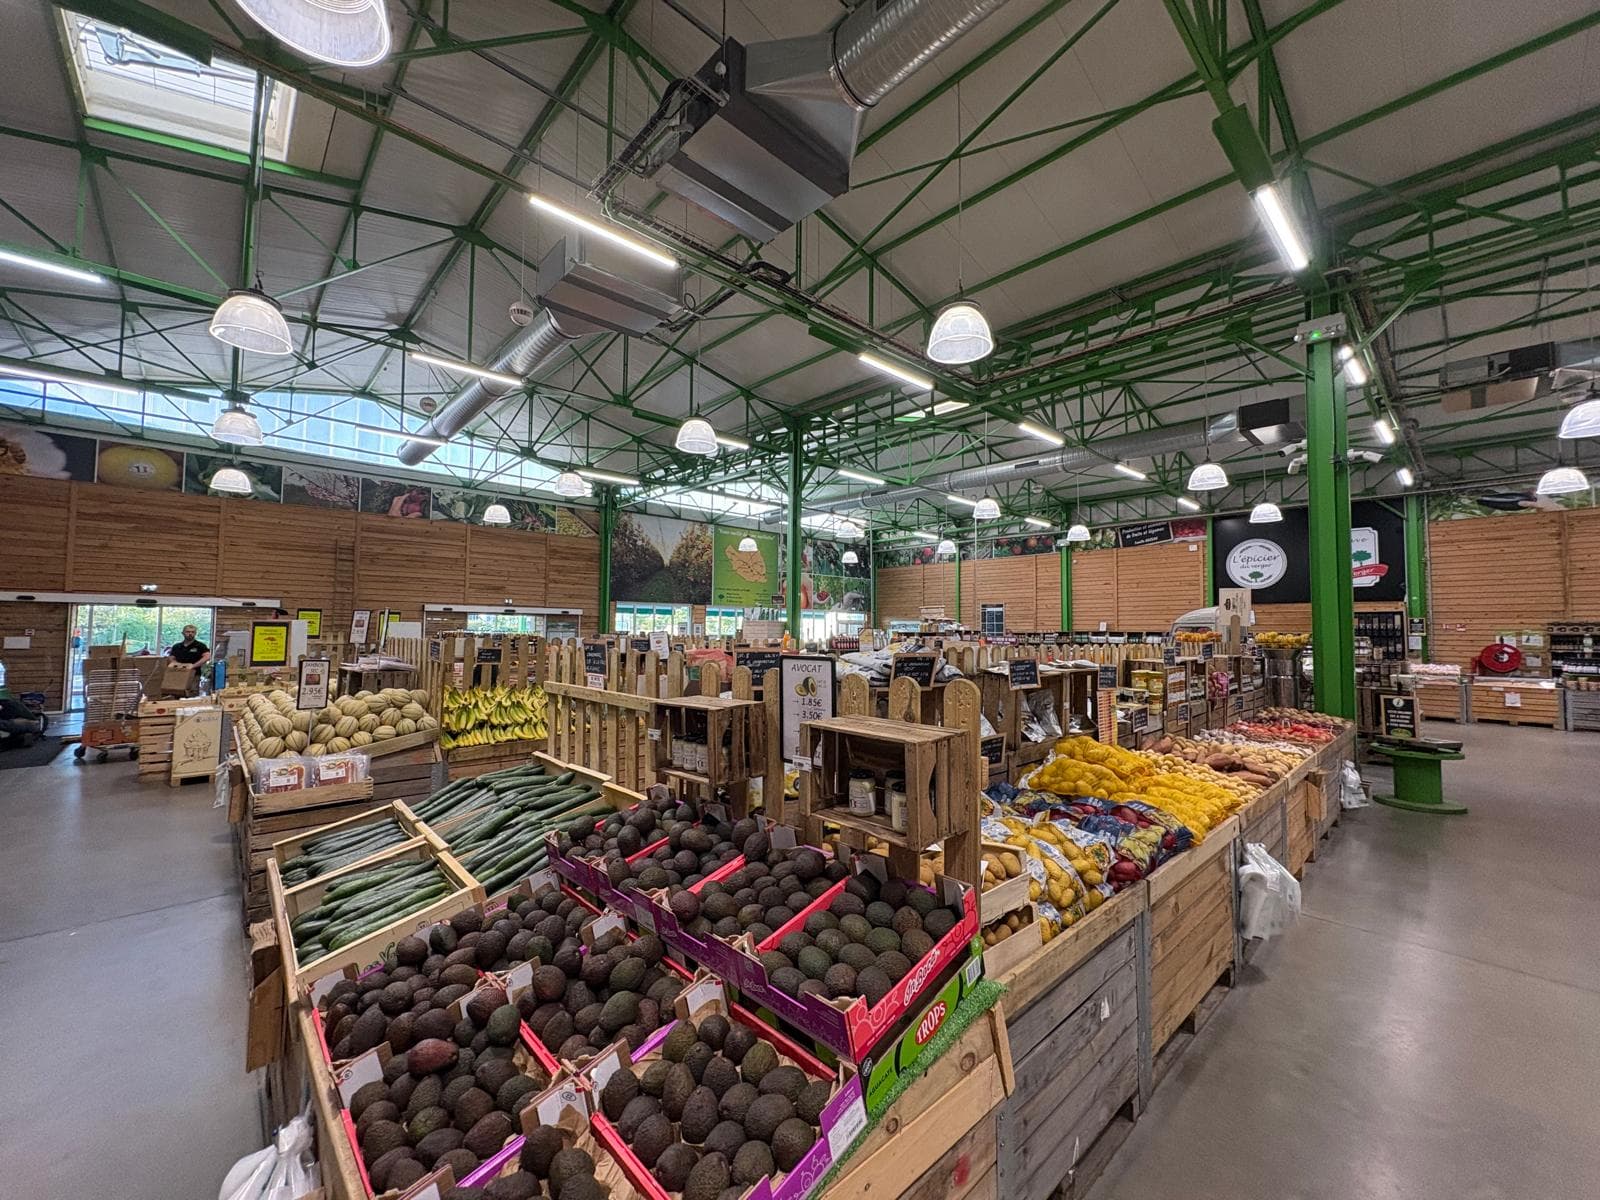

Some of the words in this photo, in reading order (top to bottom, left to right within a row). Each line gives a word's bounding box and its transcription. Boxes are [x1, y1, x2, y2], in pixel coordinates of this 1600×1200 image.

[1232, 554, 1281, 564] L'épicier
[791, 663, 822, 673] AVOCAT
[302, 687, 324, 695] 2.95€
[801, 698, 822, 707] 1.85€
[801, 710, 823, 719] 3.50€
[916, 1002, 946, 1044] TROPS
